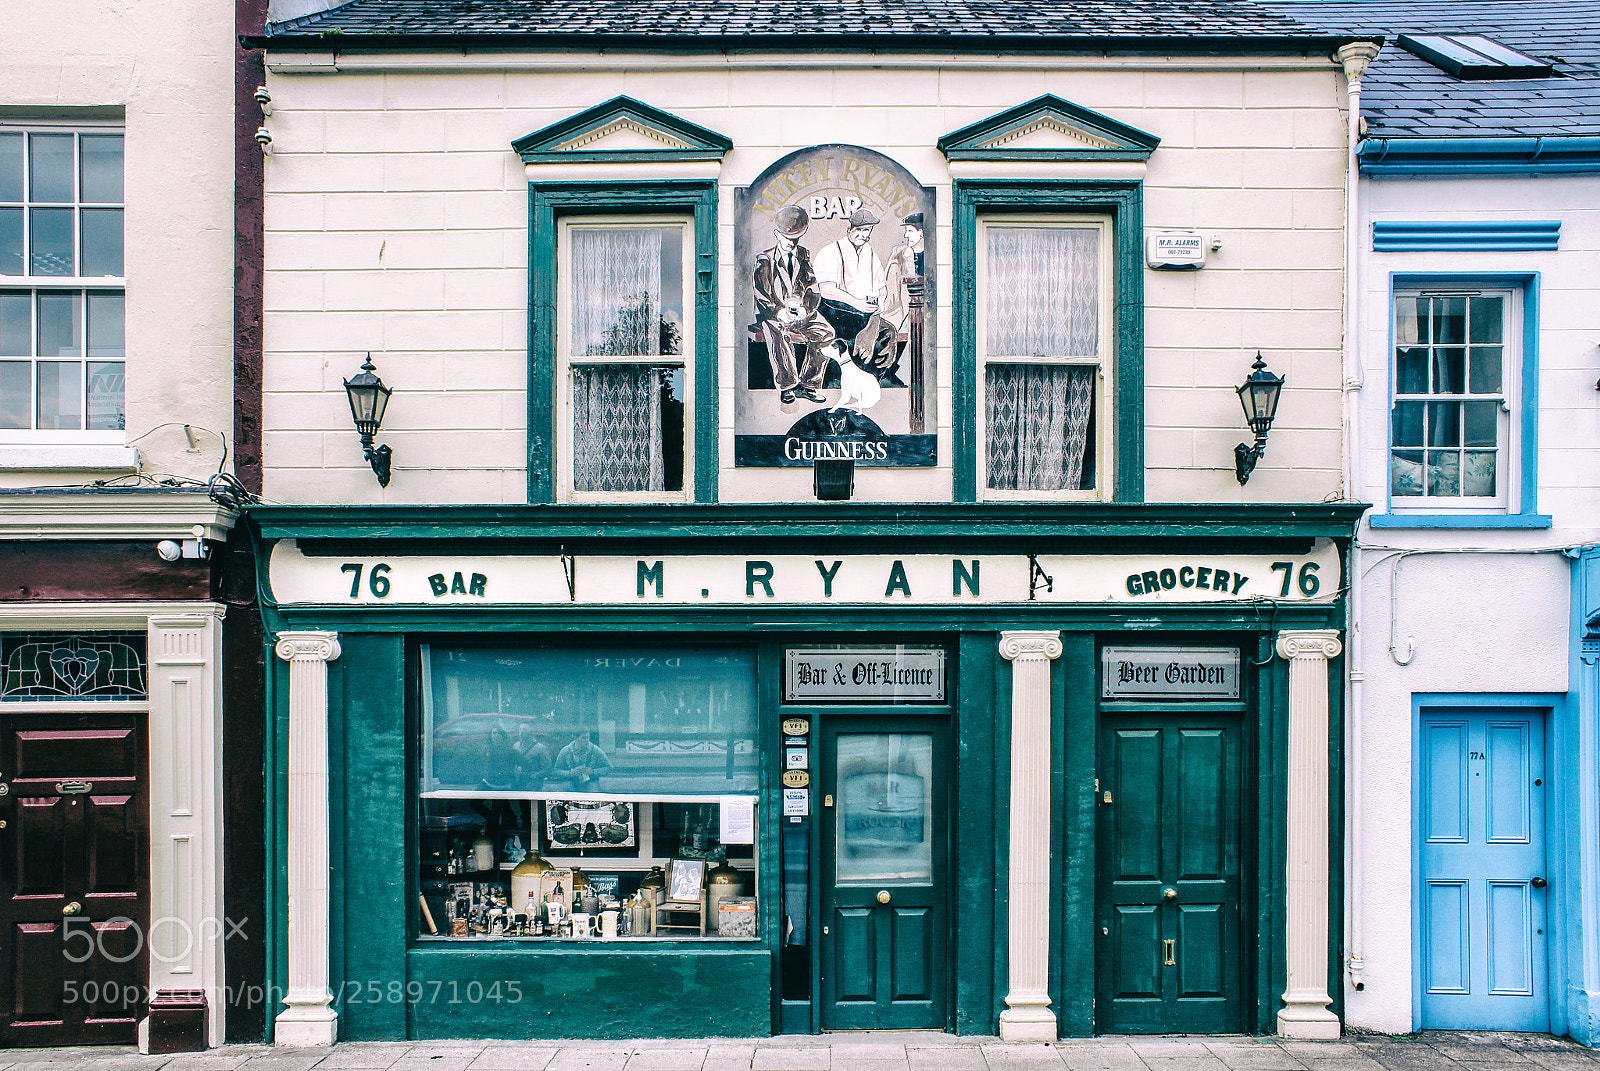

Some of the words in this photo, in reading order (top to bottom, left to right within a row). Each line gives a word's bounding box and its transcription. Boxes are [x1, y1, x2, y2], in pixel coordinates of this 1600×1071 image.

[753, 157, 834, 222] MIKEY
[839, 157, 918, 218] RYANS
[810, 196, 863, 219] BAR
[1174, 239, 1200, 247] ALARMS
[784, 437, 888, 461] GUINNESS
[340, 562, 392, 599] 76
[427, 571, 488, 598] BAR
[1126, 565, 1249, 597] GROCERY
[1270, 561, 1321, 597] 76
[797, 661, 828, 688] Bar
[832, 662, 847, 686] &
[852, 661, 933, 687] Off-Licence
[1117, 660, 1160, 687] Beer
[1164, 661, 1226, 686] Garden
[596, 881, 618, 893] Bass
